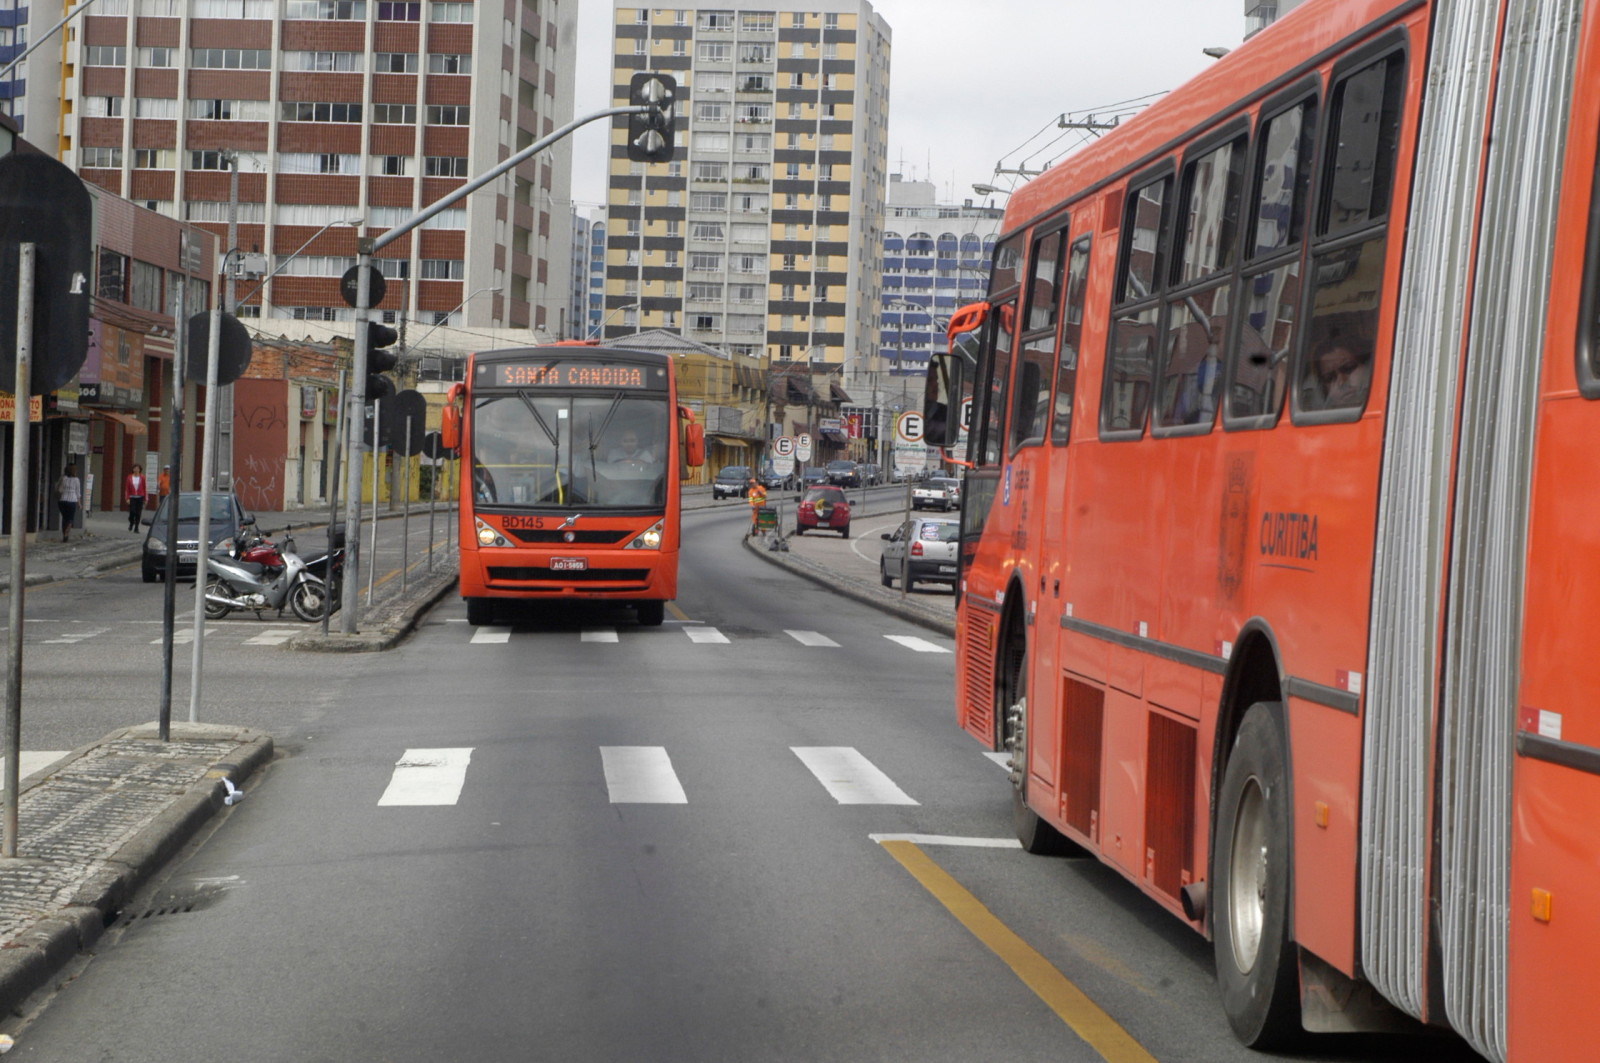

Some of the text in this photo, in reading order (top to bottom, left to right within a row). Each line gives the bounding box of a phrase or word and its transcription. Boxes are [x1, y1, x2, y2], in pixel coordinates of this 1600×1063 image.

[505, 366, 641, 386] SANTA CANDIDA
[906, 417, 919, 436] E
[779, 440, 789, 453] E
[801, 436, 808, 445] E
[502, 516, 544, 529] BD145
[1260, 512, 1318, 560] CURITIBA
